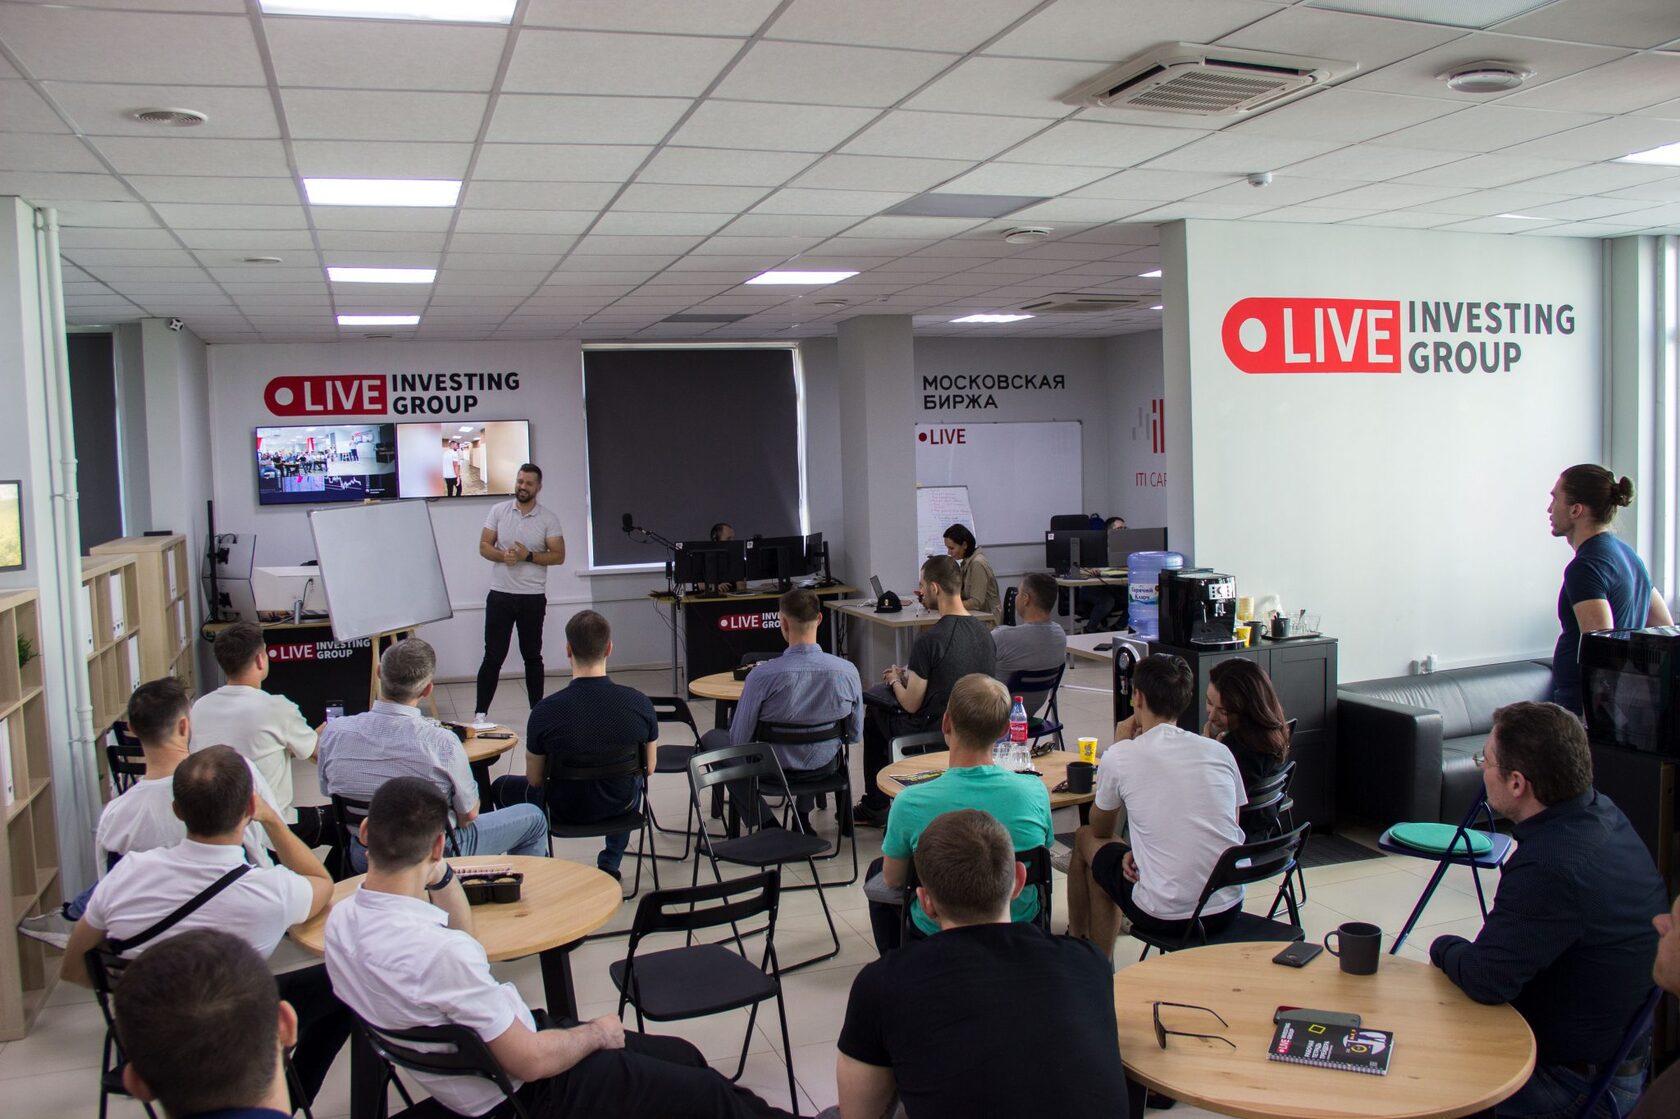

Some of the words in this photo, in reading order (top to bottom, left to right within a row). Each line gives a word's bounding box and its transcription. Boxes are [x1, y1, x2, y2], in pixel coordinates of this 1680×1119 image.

[1284, 307, 1394, 364] LIVE
[1408, 300, 1575, 335] INVESTING
[1408, 341, 1522, 374] GROUP
[923, 374, 1065, 391] МОСКОВСКАЯ
[304, 379, 383, 411] LIVE
[392, 372, 520, 392] INVESTING
[392, 395, 478, 415] GROUP
[924, 394, 998, 410] БИРЖА
[930, 428, 967, 445] LIVE
[1135, 472, 1147, 487] ITI
[731, 615, 759, 628] LIVE
[280, 645, 313, 659] LIVE
[316, 639, 371, 650] INVESTING
[316, 649, 353, 660] GROUP
